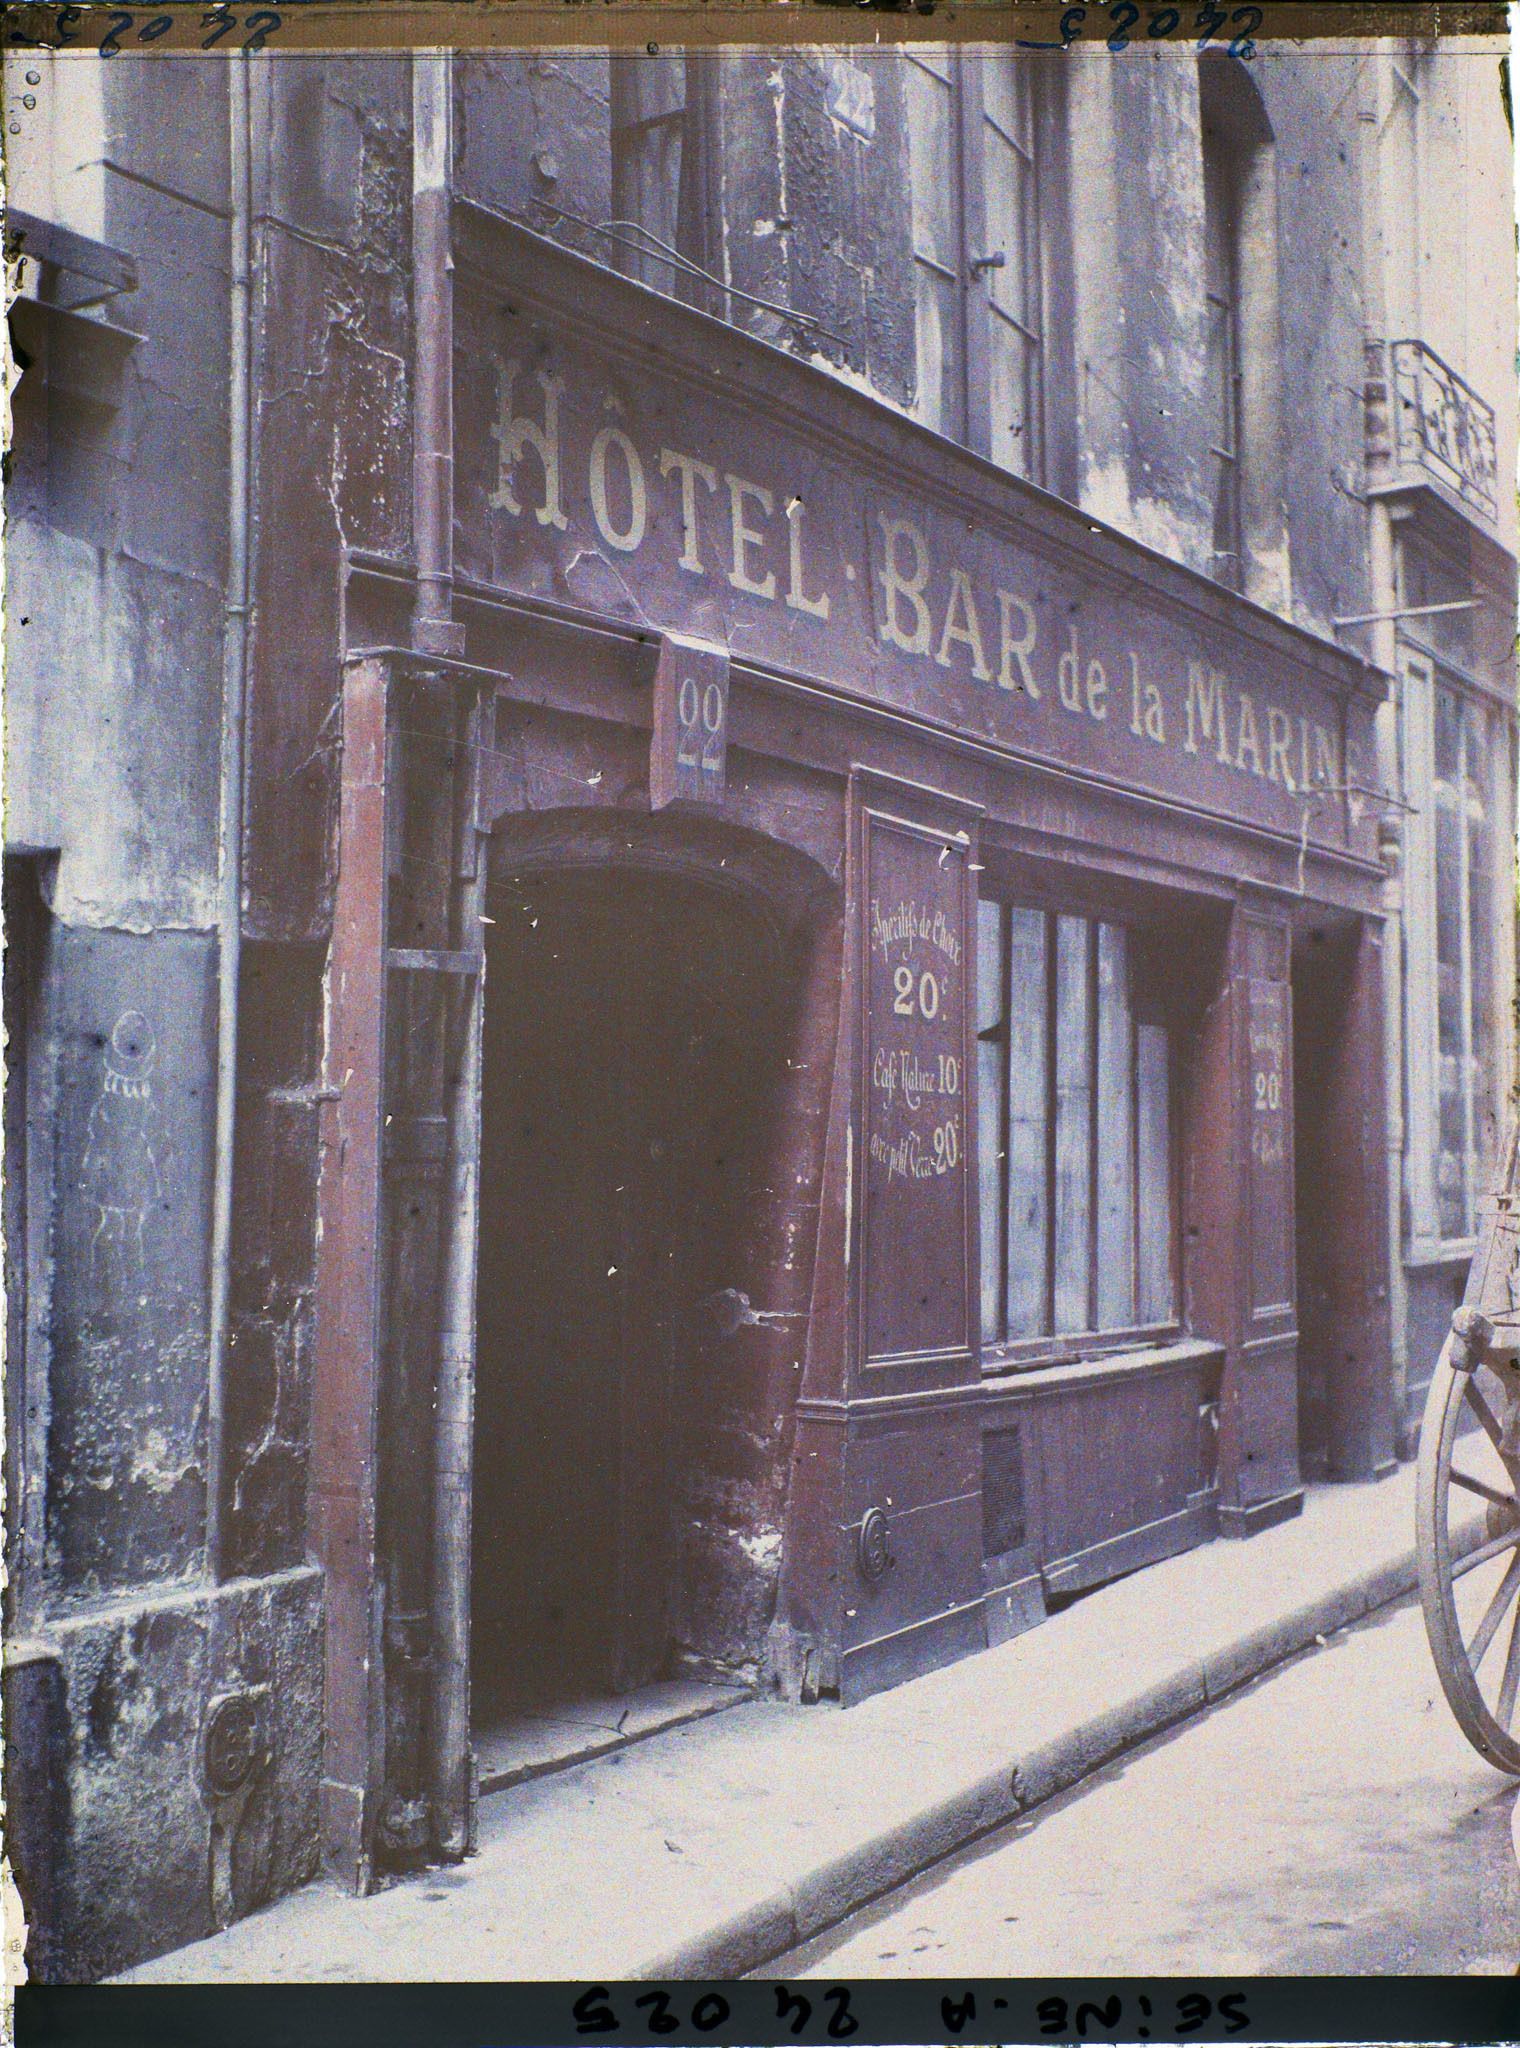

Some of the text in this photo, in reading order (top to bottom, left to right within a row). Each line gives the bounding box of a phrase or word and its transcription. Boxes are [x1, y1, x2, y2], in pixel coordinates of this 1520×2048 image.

[879, 508, 1042, 700] BAR
[1058, 624, 1107, 720] de
[1131, 651, 1165, 744] la
[919, 905, 931, 940] de
[932, 910, 961, 966] Choix
[874, 1047, 898, 1109] Café
[900, 1050, 935, 1110] Nature
